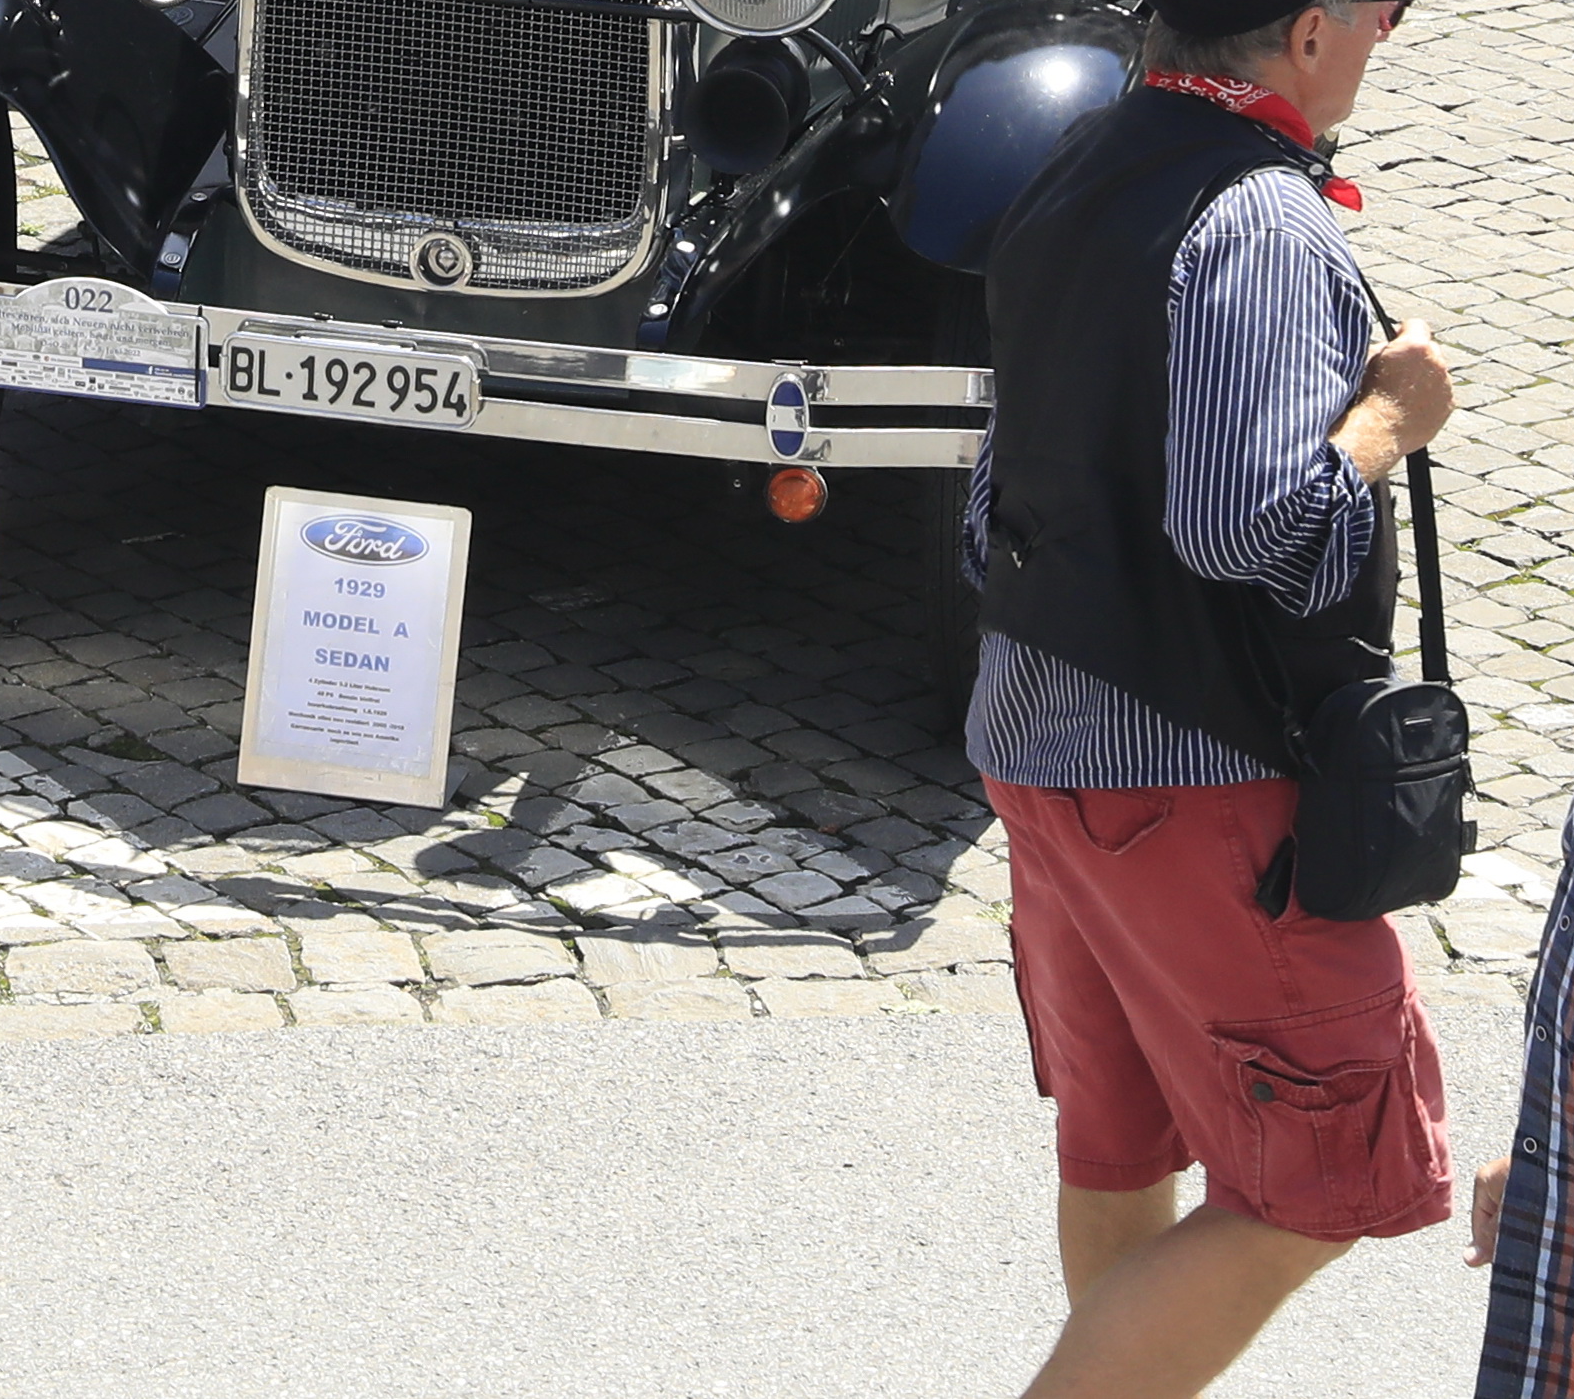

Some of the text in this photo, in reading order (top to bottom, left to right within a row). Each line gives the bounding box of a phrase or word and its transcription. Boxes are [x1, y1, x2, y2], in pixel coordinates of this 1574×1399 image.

[65, 286, 114, 314] 022
[323, 520, 406, 560] Ford
[333, 577, 386, 599] 1929
[302, 609, 410, 639] MODEL A
[314, 648, 391, 673] SEDAN
